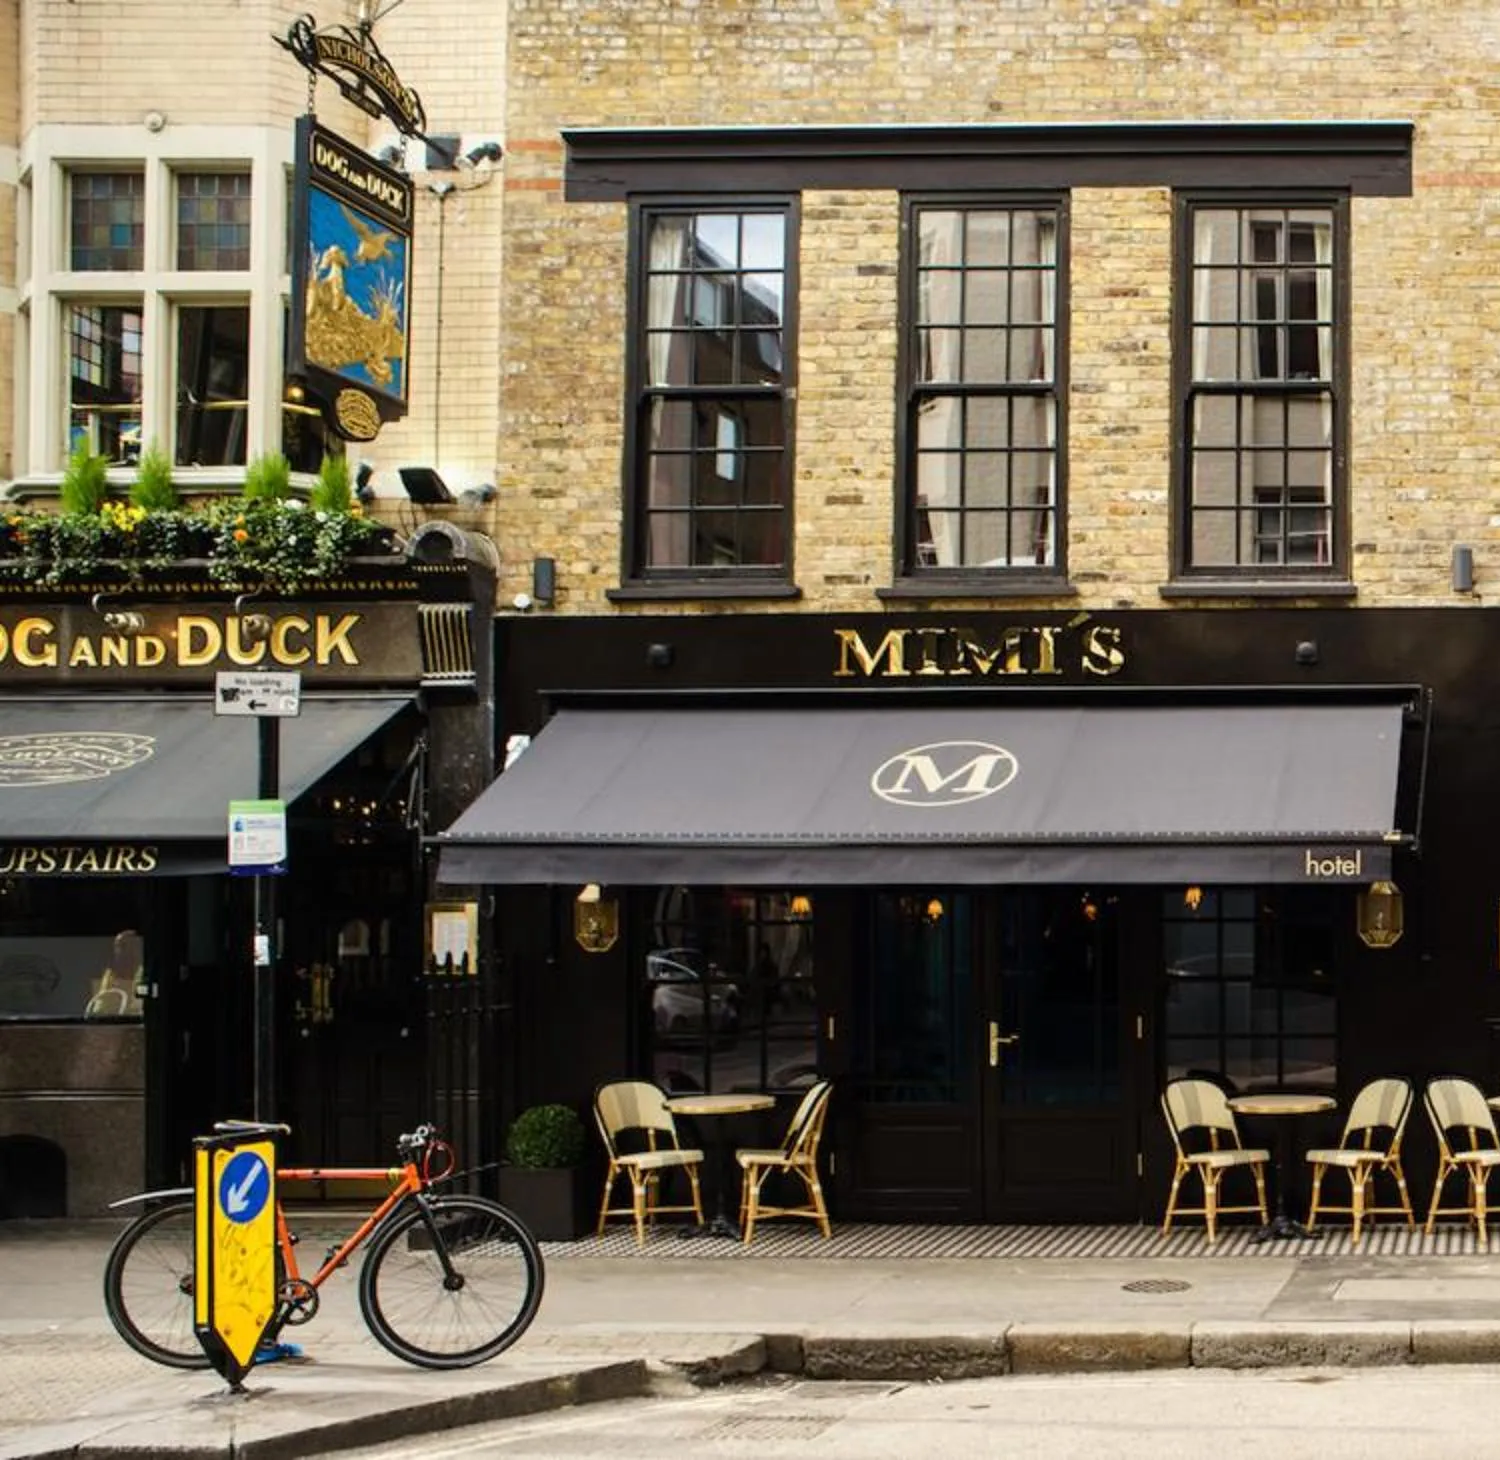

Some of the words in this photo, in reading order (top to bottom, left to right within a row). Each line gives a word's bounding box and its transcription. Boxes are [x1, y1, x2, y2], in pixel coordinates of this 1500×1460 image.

[315, 143, 348, 180] DOG
[367, 172, 405, 212] DUCK
[68, 635, 166, 667] AND
[176, 614, 361, 666] DUCK
[881, 753, 1008, 795] M
[1305, 848, 1361, 876] hotel
